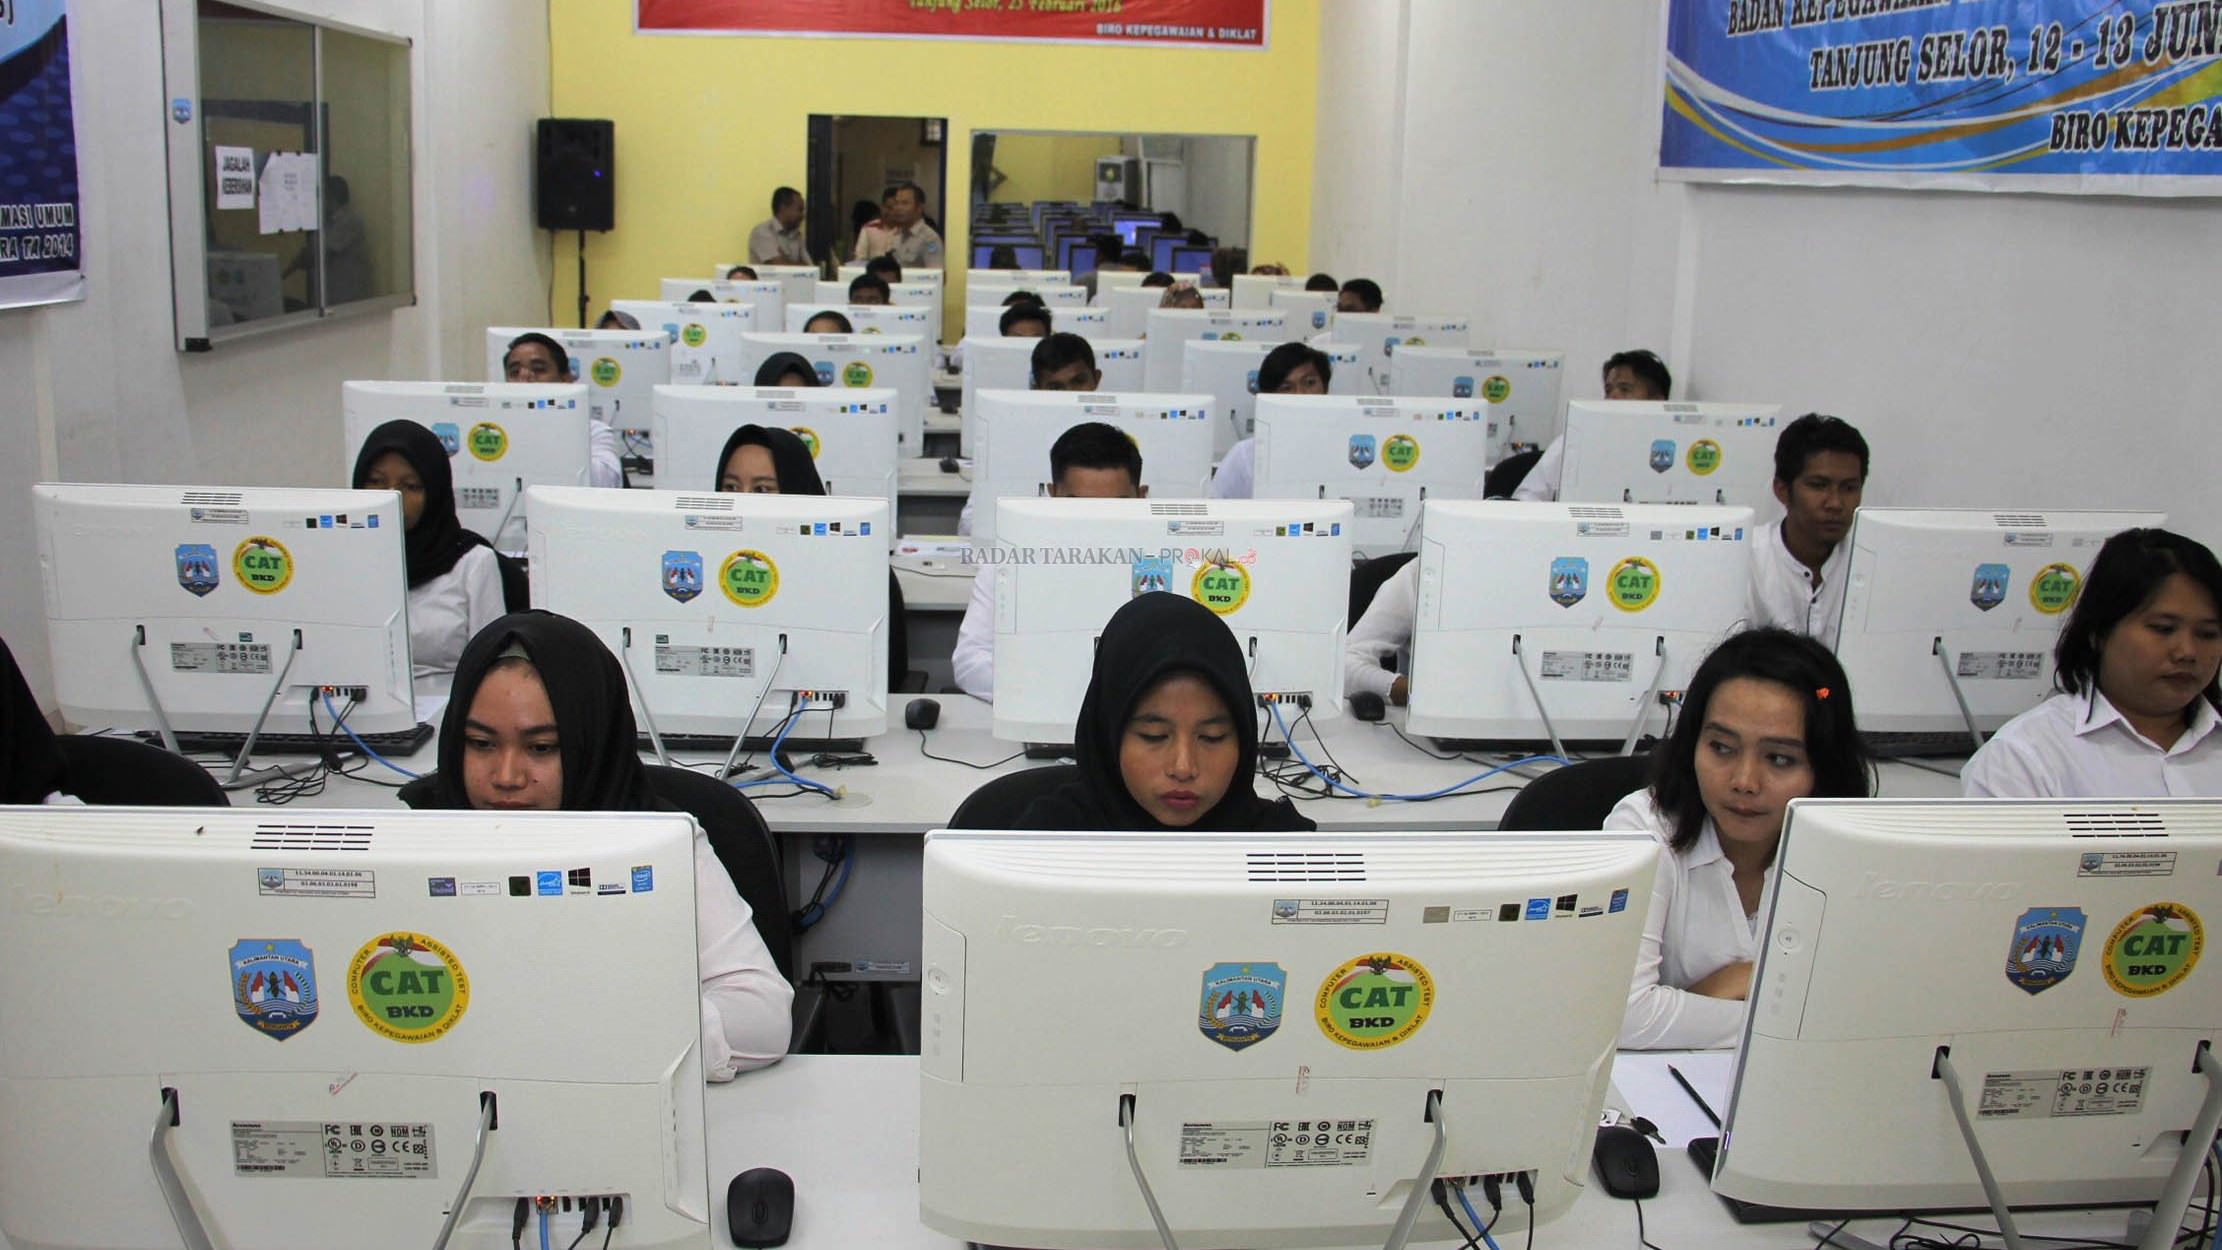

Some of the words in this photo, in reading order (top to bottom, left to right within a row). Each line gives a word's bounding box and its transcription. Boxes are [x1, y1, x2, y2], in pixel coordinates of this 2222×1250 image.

[1727, 0, 1784, 38] BADAN
[1096, 23, 1122, 36] BIRO
[1126, 24, 1204, 38] KEPEGAWAIAN
[1207, 28, 1215, 38] &
[1218, 28, 1257, 40] DIKLAT
[1809, 37, 1912, 91] TANJUNG
[1916, 25, 2015, 85] SELOR,
[2026, 20, 2063, 76] 12
[2070, 40, 2084, 60] -
[2093, 11, 2135, 69] 13
[2144, 0, 2222, 66] JUN
[2049, 109, 2110, 152] BIRO
[2112, 103, 2222, 152] KEPEGA
[34, 203, 74, 228] UMUM
[23, 236, 40, 260] TA
[42, 233, 74, 259] 2014
[244, 555, 282, 570] CAT
[731, 568, 768, 583] CAT
[1203, 577, 1239, 591] CAT
[1617, 576, 1651, 588] CAT
[2041, 580, 2074, 592] CAT
[2123, 935, 2187, 956] CAT
[352, 949, 370, 994] COMPUTER
[421, 938, 458, 970] ASSISTED
[456, 971, 466, 994] TEST
[2128, 965, 2166, 976] BKD
[370, 970, 444, 996] CAT
[1320, 969, 1347, 1009] COMPUTER
[1397, 959, 1429, 987] ASSISTED
[1423, 986, 1432, 1006] TEST
[1339, 986, 1413, 1009] CAT
[357, 1004, 374, 1023] BIRO
[373, 1022, 435, 1040] KEPEGAWAIAN
[442, 1004, 463, 1028] DIKLAT
[385, 1005, 434, 1019] BKD
[1349, 1017, 1395, 1029] BKD
[1321, 1017, 1335, 1033] BIRO
[1334, 1032, 1391, 1048] KEPEGAWAIAN
[1399, 1014, 1423, 1038] DIKLAT
